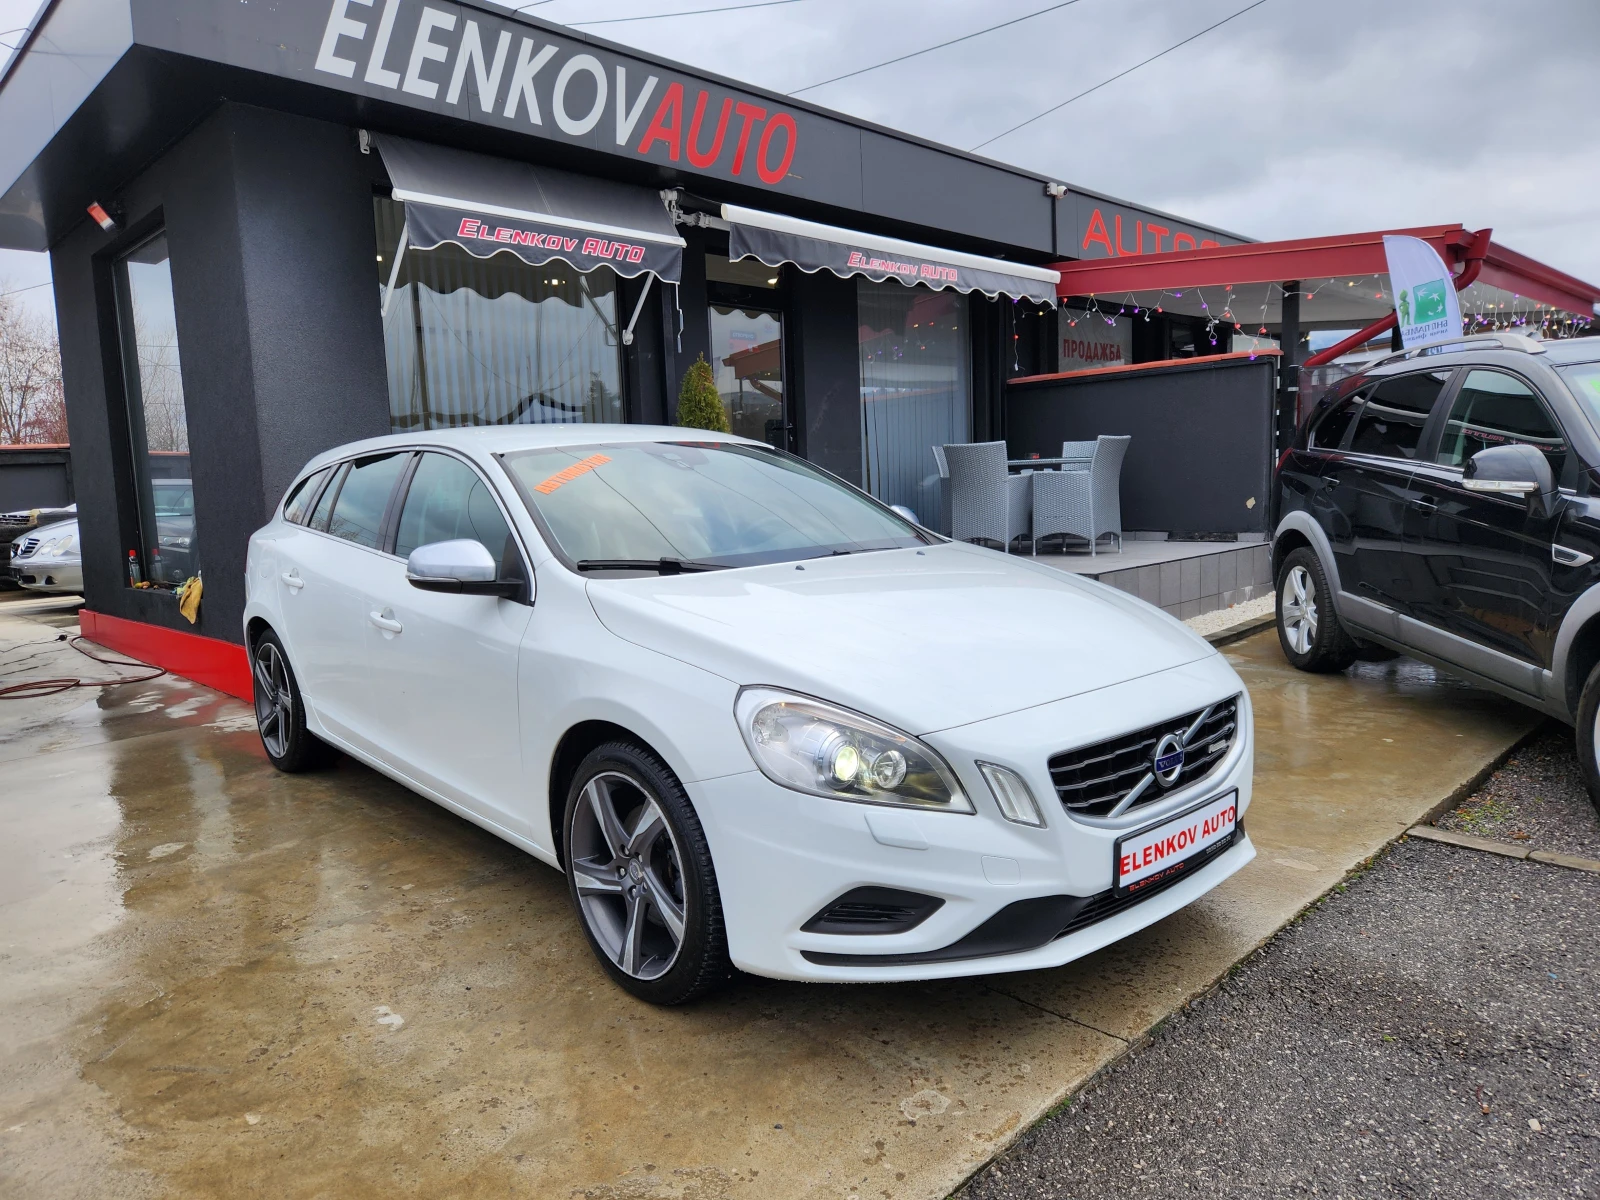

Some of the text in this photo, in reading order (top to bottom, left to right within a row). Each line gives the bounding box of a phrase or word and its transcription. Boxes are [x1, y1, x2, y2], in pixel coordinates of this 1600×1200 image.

[457, 217, 646, 263] ELENKOV AUTO
[847, 251, 958, 282] ELENKOV AUTO
[1063, 338, 1122, 362] ПРОДАЖБА
[1120, 824, 1198, 876] ELENKOV
[1201, 805, 1236, 839] AUTO
